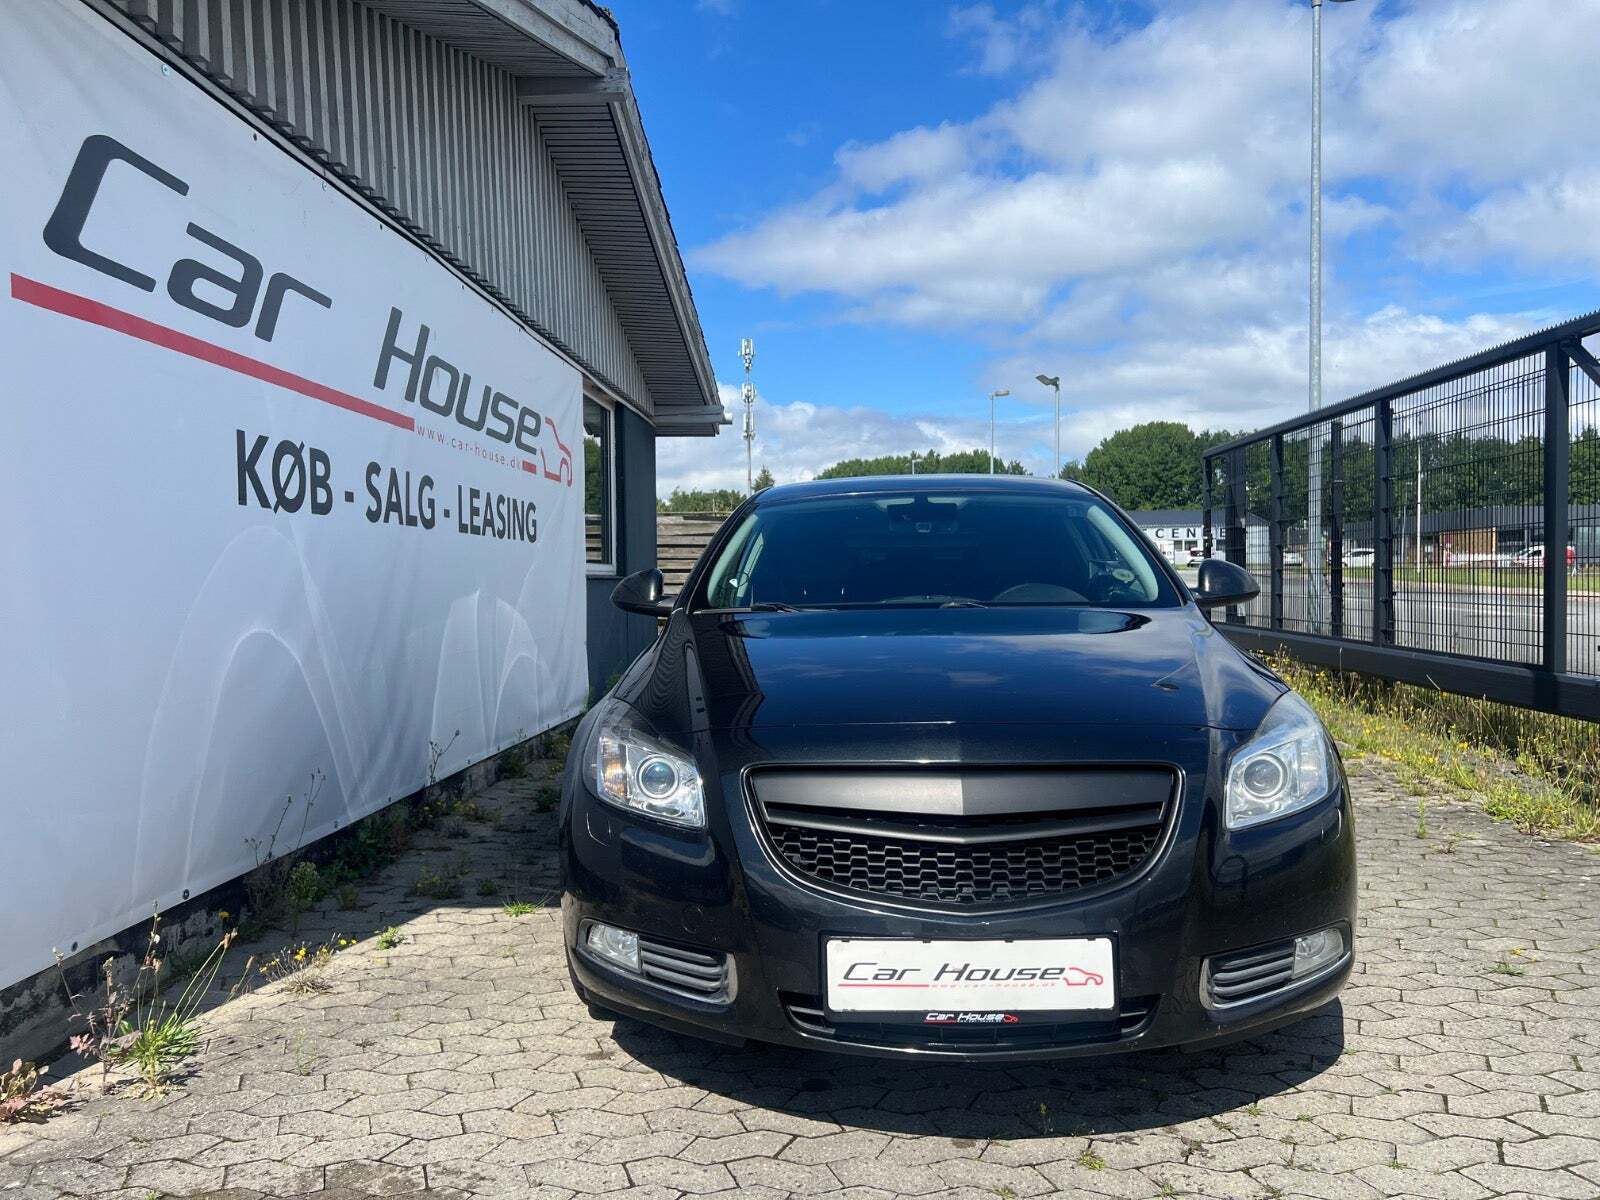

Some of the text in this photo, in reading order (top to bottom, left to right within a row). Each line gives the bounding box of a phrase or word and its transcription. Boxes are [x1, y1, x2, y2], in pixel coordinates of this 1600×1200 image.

[43, 134, 541, 455] Car House
[416, 424, 522, 470] www.car-house.dk
[236, 429, 537, 543] KØB - SALG - LEASING
[843, 963, 1066, 981] Car House
[926, 1012, 955, 1021] Car
[957, 1012, 1005, 1022] House
